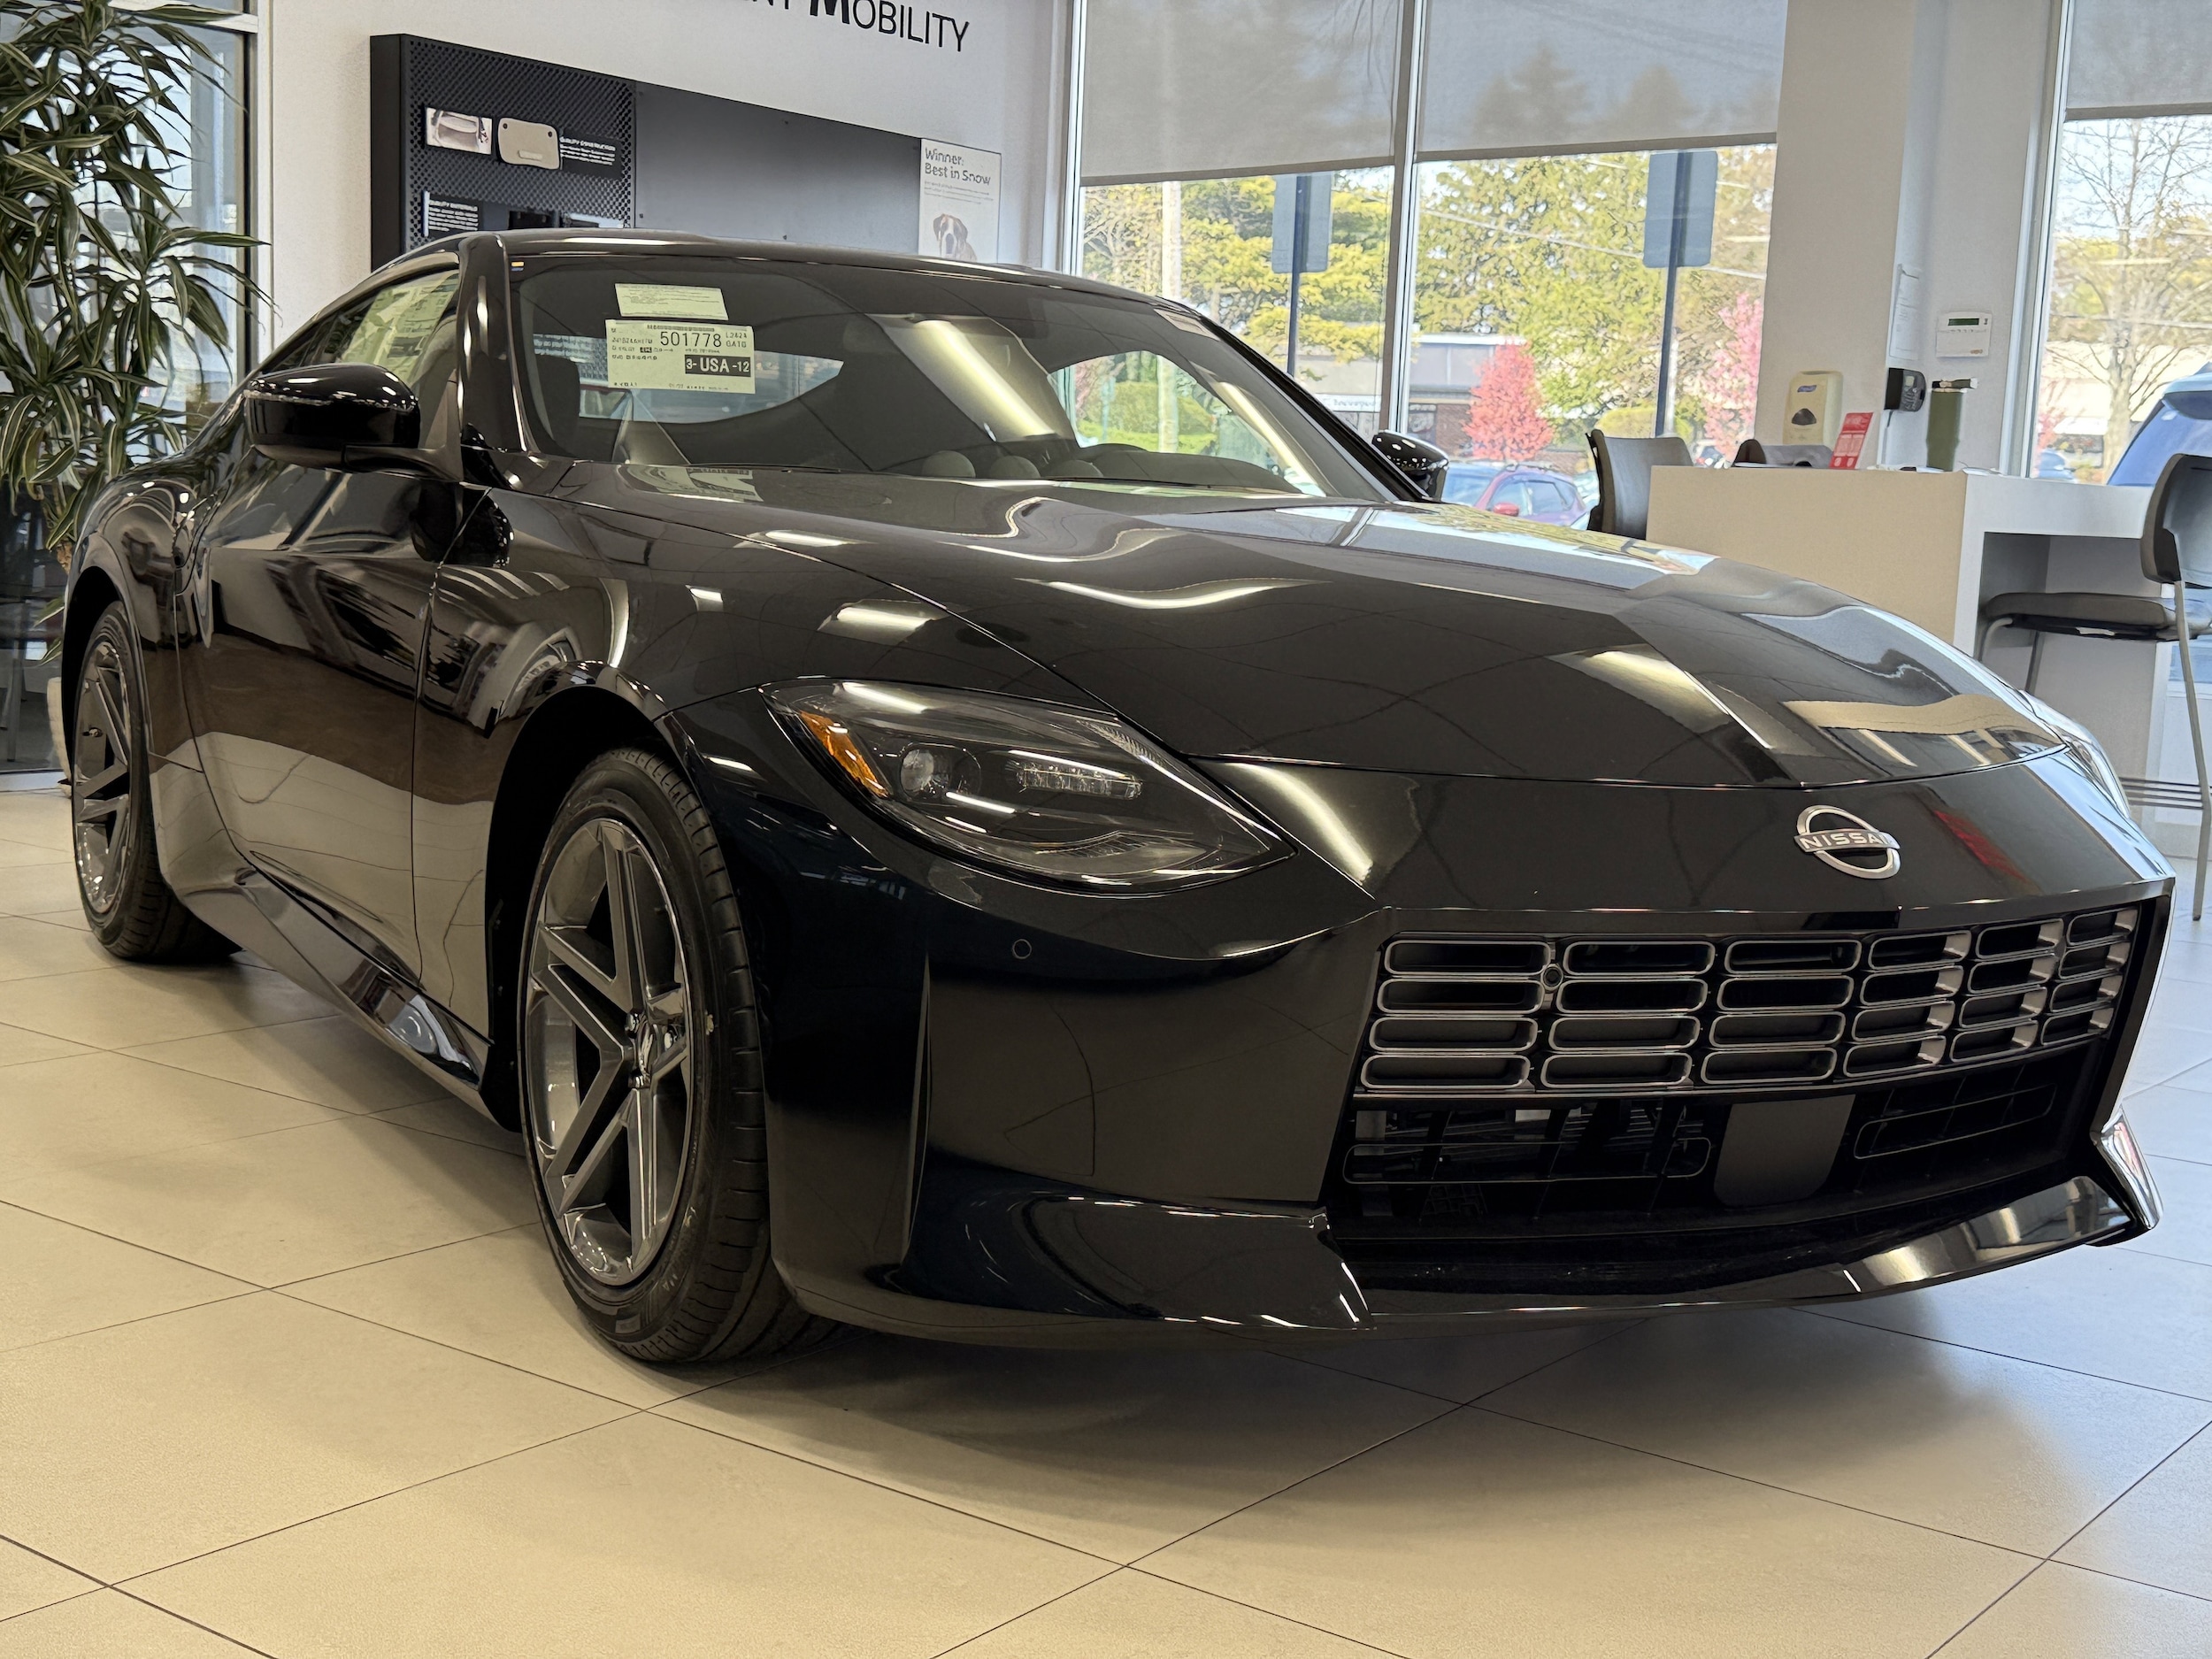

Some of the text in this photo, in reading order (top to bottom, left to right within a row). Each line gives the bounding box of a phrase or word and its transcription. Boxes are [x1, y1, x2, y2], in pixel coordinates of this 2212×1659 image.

[925, 147, 964, 166] Winner:
[925, 162, 991, 186] Best in Snow
[660, 331, 722, 348] 501778
[700, 357, 730, 373] USA
